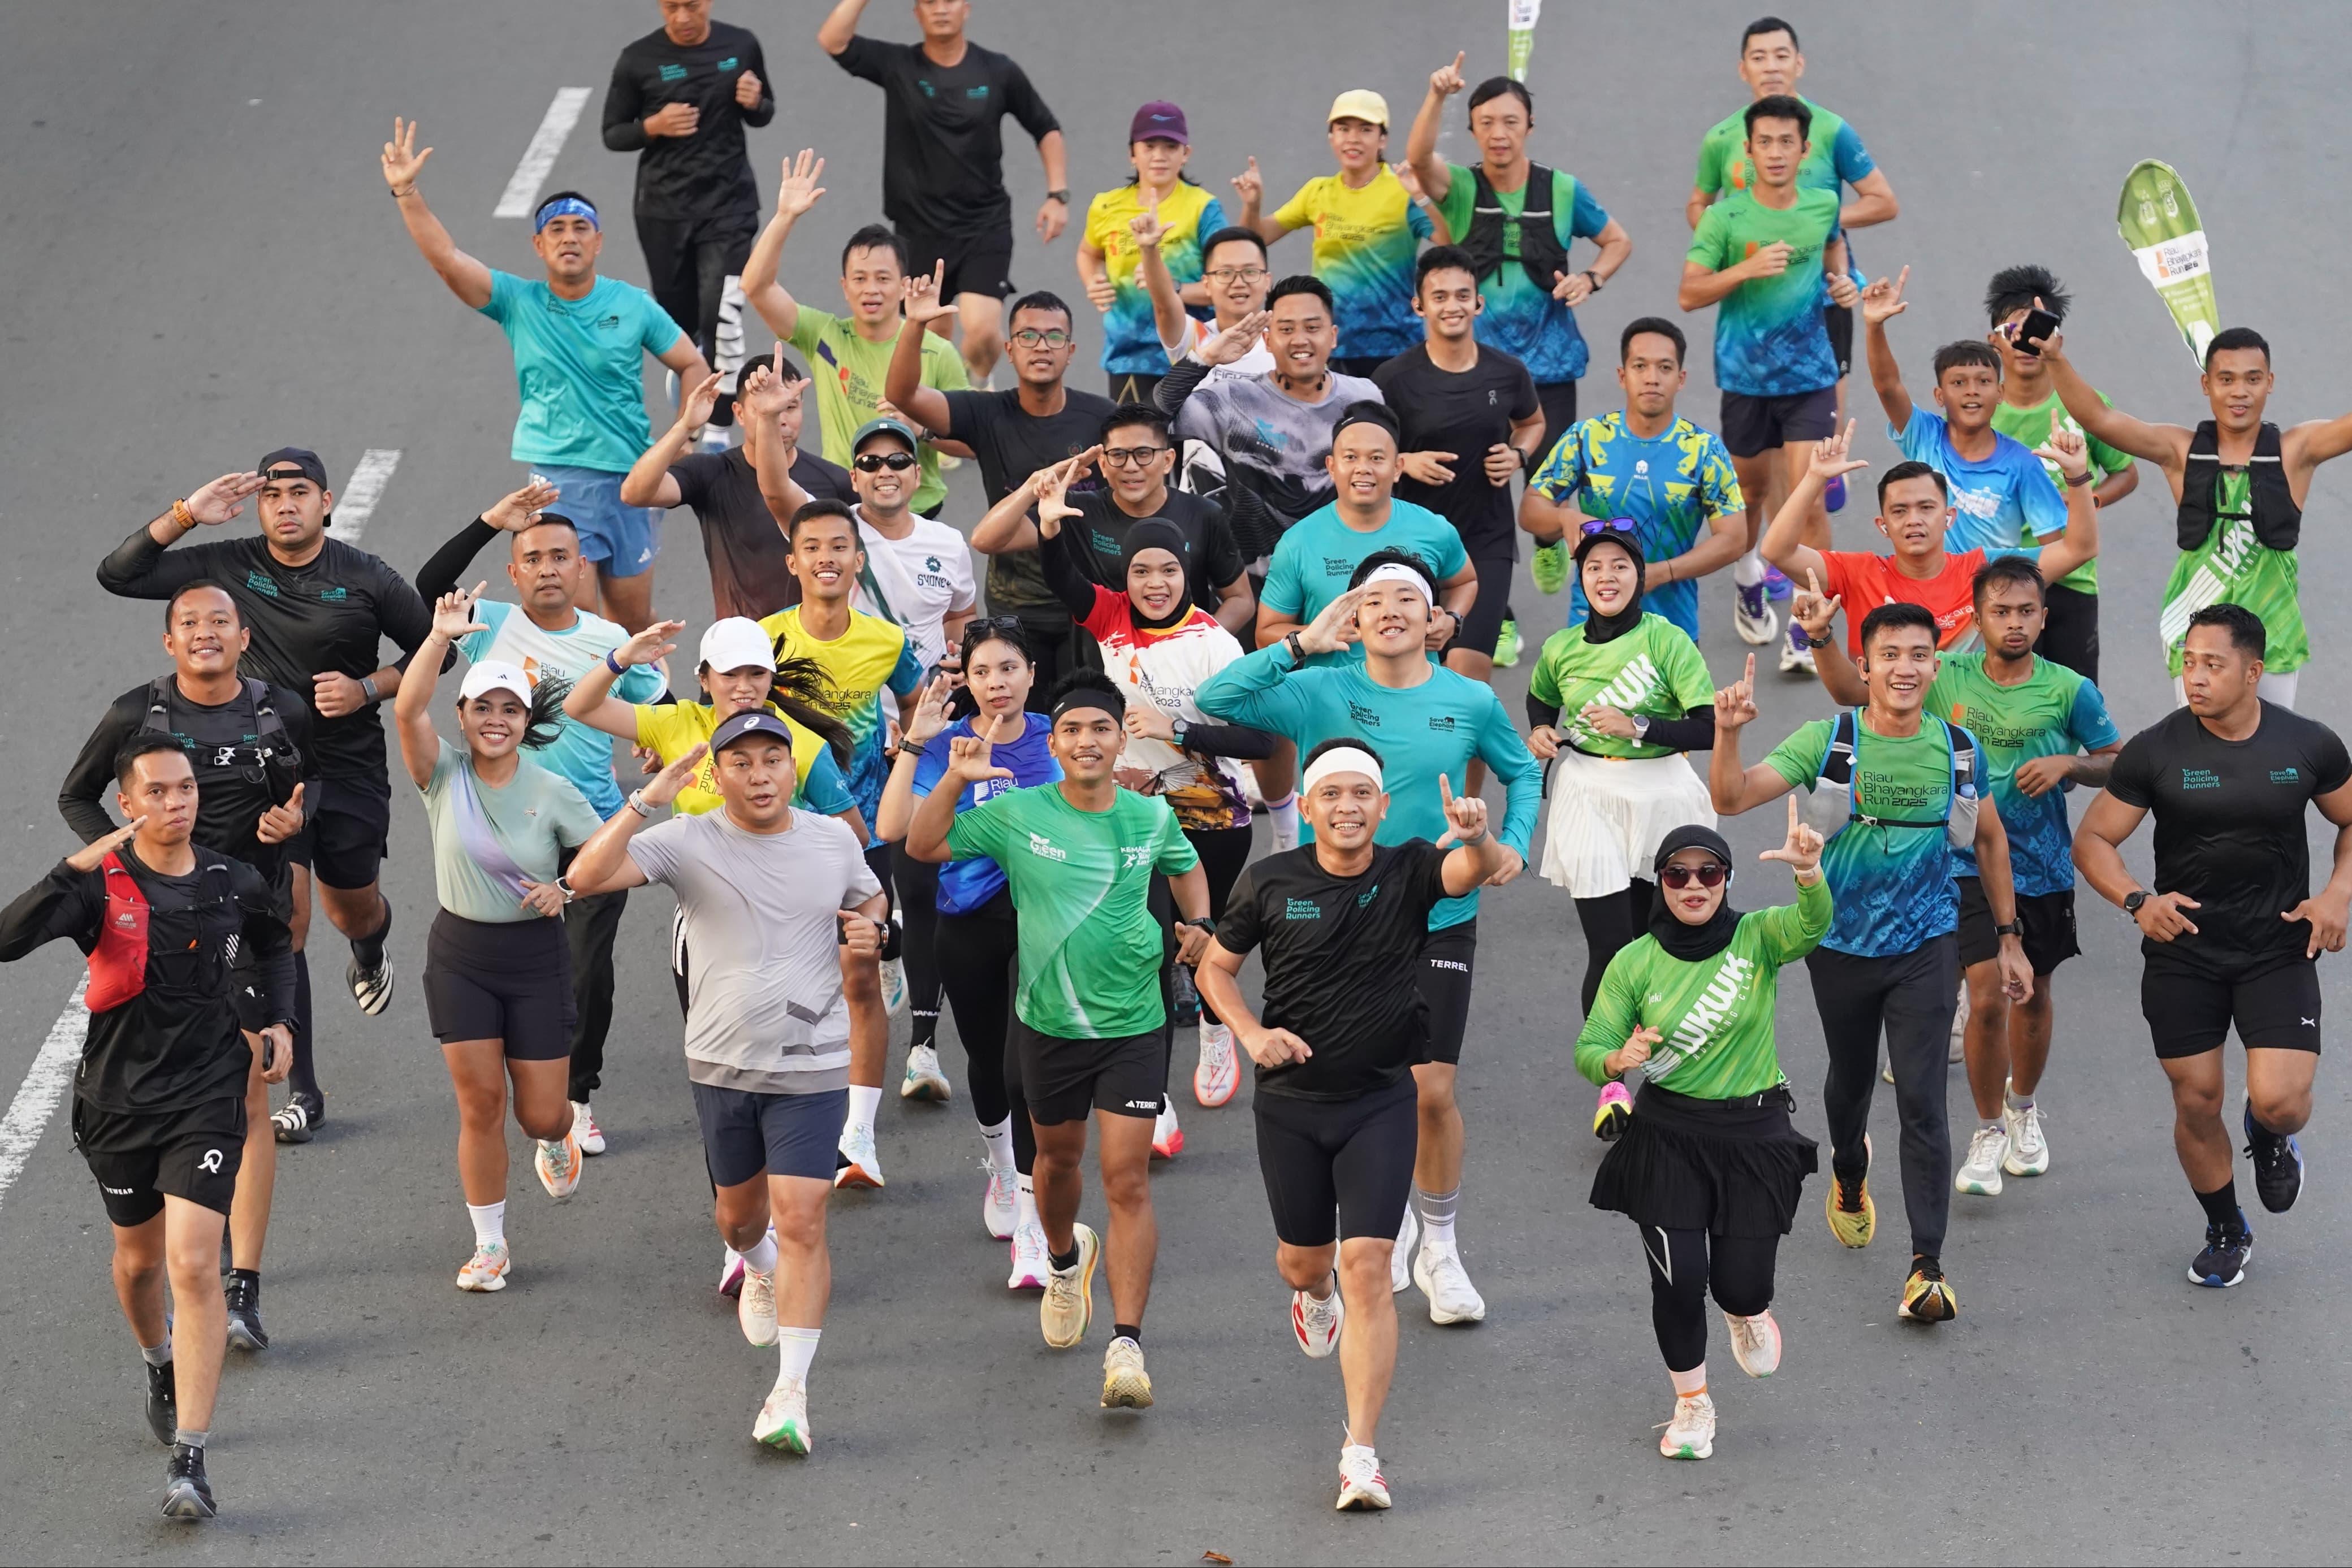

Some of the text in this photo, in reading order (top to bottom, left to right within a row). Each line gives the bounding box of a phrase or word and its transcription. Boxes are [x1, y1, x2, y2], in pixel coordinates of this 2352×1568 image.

[1787, 255, 1809, 265] 025
[1092, 529, 1114, 542] Green
[1092, 537, 1121, 551] Policing
[249, 570, 272, 584] Green
[248, 578, 278, 592] Policing
[1155, 696, 1181, 707] 2023
[1349, 700, 1372, 713] Green
[1967, 707, 1994, 722] Riau
[1966, 718, 2046, 739] Bhayangkara
[1991, 738, 2024, 748] 2025
[1864, 771, 1893, 783] Riau
[2184, 775, 2219, 783] Policing
[991, 778, 1019, 791] Riau
[1864, 782, 1948, 798] Bhayangkara
[1864, 794, 1928, 807] Run 2025
